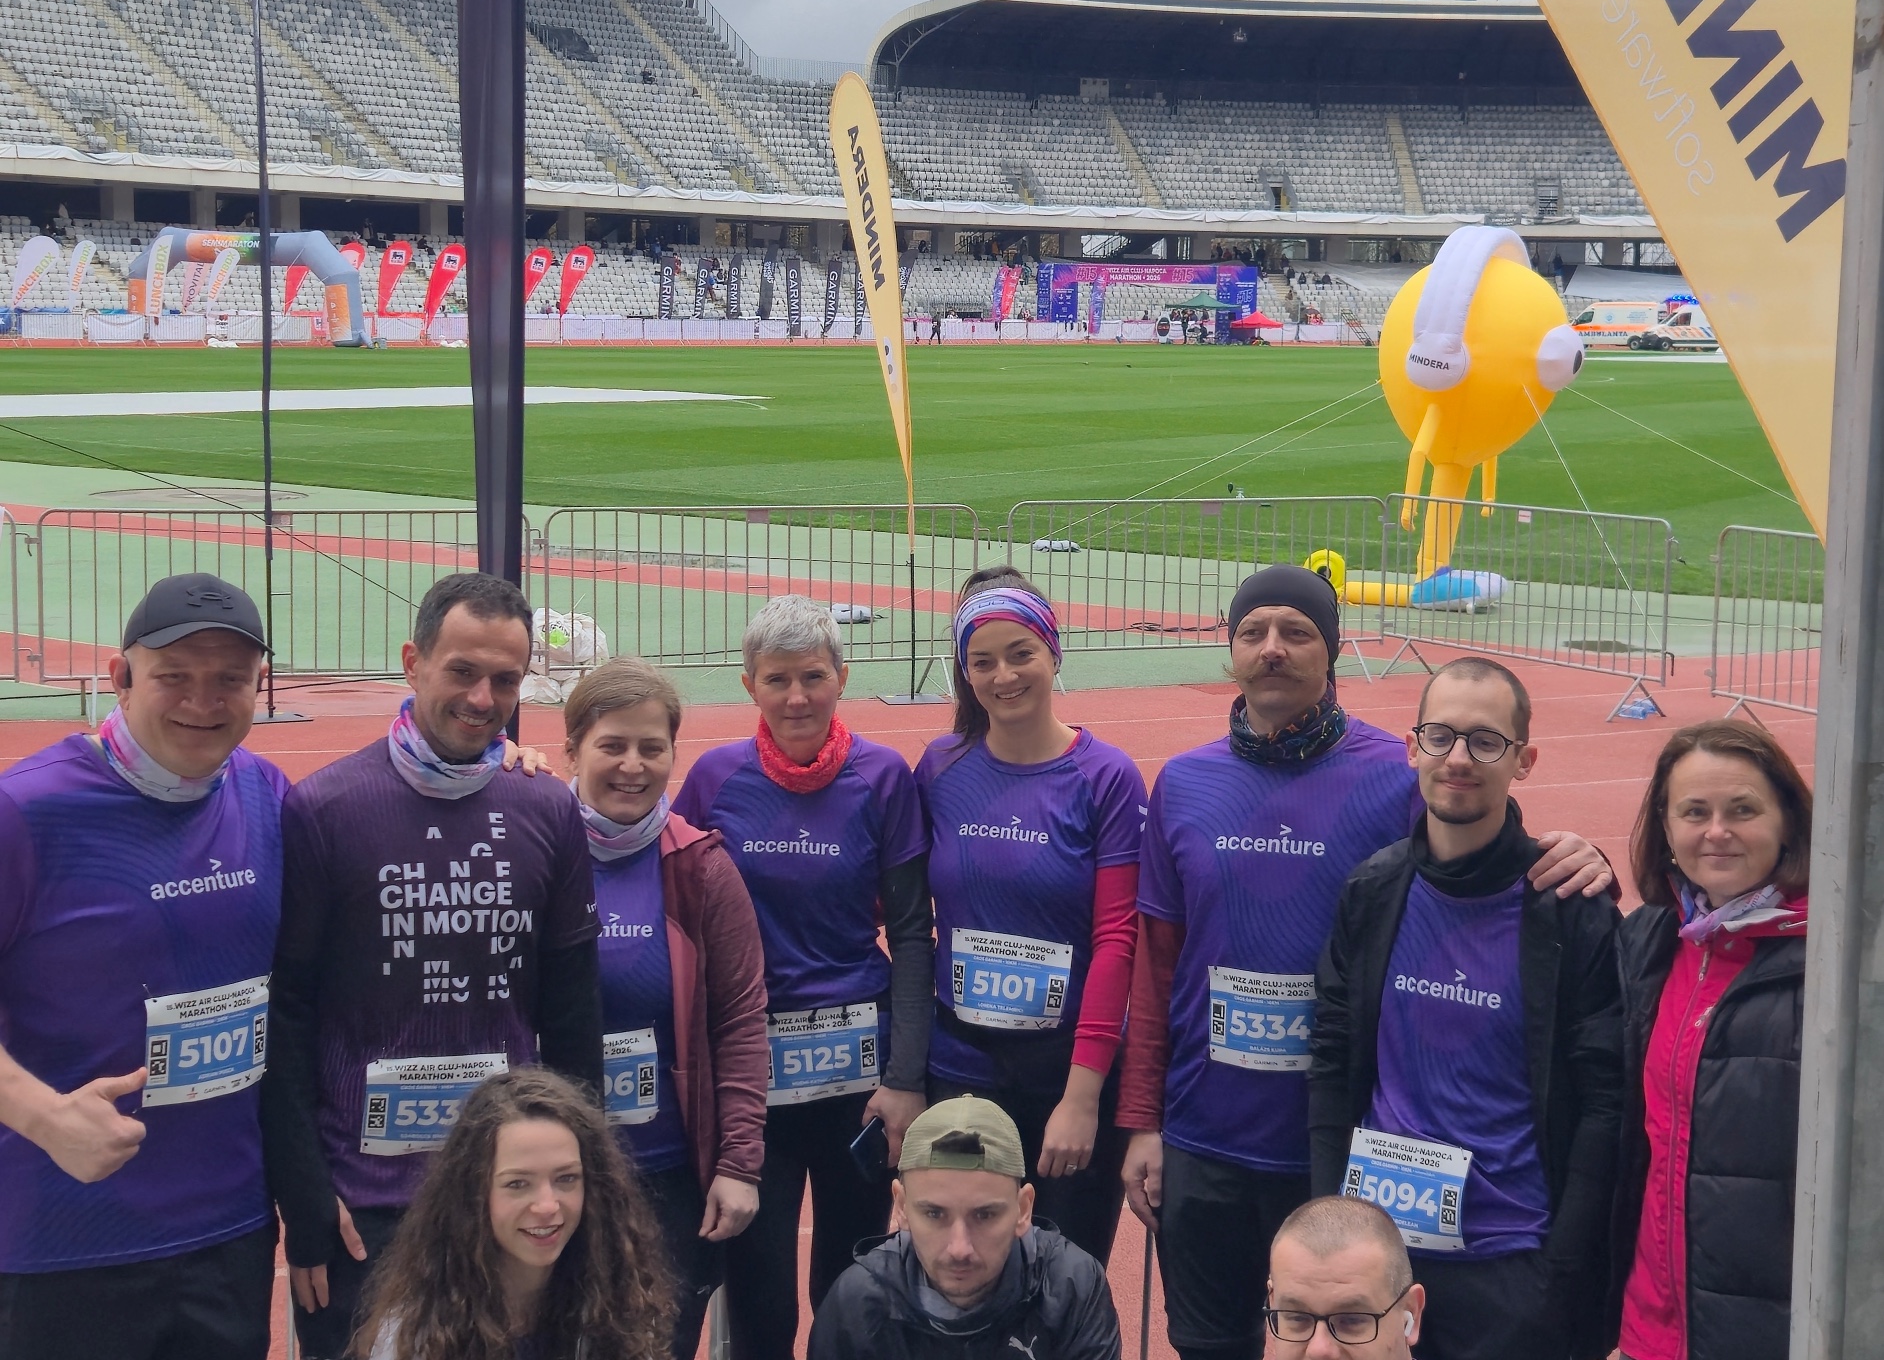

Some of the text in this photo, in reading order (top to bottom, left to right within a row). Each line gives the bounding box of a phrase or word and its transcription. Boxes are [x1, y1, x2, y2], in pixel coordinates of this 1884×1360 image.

[70, 242, 92, 293] LUNCHBOX
[150, 244, 169, 315] LUNCHBOX
[209, 251, 237, 300] LUNCHBOX
[661, 266, 673, 320] GARMIN
[694, 268, 708, 320] GARMIN
[730, 267, 739, 315] GARMIN
[788, 269, 800, 326] GARMIN
[825, 270, 838, 325] GARMIN
[1409, 353, 1450, 371] MINDERA
[743, 836, 841, 857] accenture
[958, 822, 1050, 845] accenture
[1215, 834, 1327, 857] accenture
[150, 866, 257, 901] accenture
[379, 881, 513, 910] CHANGE
[381, 909, 533, 937] IN MOTION
[597, 922, 654, 938] nture
[972, 944, 1046, 962] MARATHON 2026
[989, 939, 1003, 947] AIR
[1003, 940, 1057, 956] CLUJ-NAPOCA
[198, 997, 212, 1006] AIR
[212, 986, 256, 1003] CLUJ-NAPOCA
[971, 969, 1036, 1002] 5101
[1232, 984, 1310, 997] MARATHON 2026
[1248, 978, 1261, 986] AIR
[1262, 980, 1314, 988] CLUJ-NAPOC
[1394, 972, 1503, 1010] accenture
[179, 996, 251, 1019] MARATHON 2026
[778, 1020, 853, 1034] MARATHON 2026
[1229, 1009, 1311, 1041] 5334
[177, 1025, 249, 1068] 5107
[610, 1046, 632, 1055] 2026
[783, 1043, 853, 1075] 5125
[399, 1071, 486, 1081] MARATHON 2026
[420, 1064, 436, 1072] AIR
[437, 1061, 495, 1071] CLUJ-NAPOCA
[394, 1100, 460, 1126] 533
[1371, 1147, 1441, 1168] MARATHON 2026
[1387, 1141, 1399, 1150] AIR
[1400, 1144, 1453, 1161] CLUJ-NAPOCA
[1360, 1174, 1438, 1217] 5094
